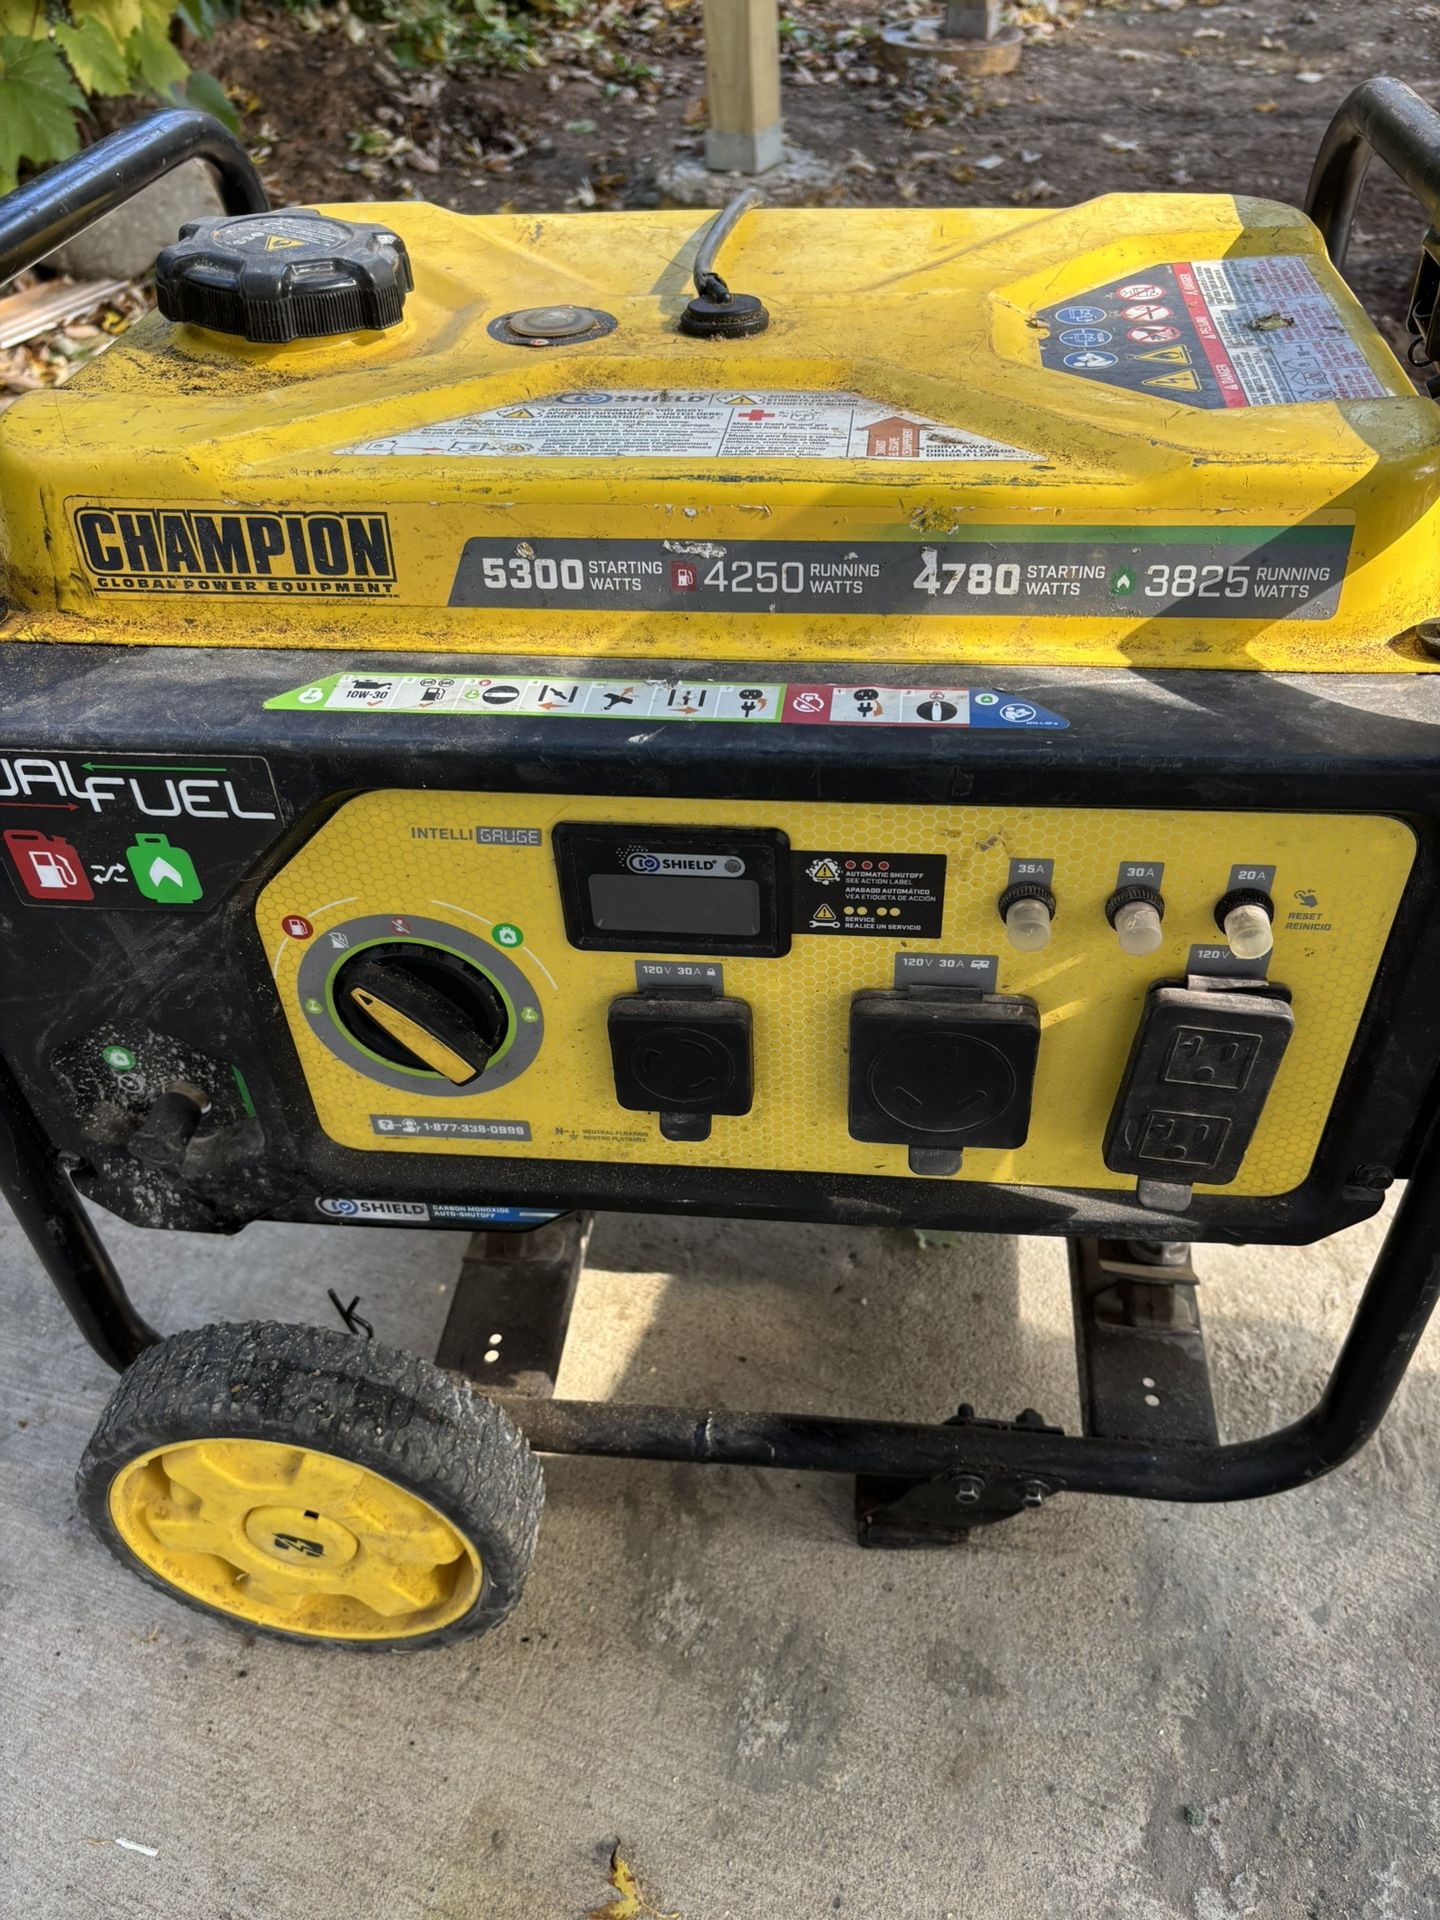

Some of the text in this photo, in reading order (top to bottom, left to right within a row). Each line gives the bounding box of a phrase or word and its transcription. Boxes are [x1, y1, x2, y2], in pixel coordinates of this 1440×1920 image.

[614, 395, 706, 403] SHIELD
[77, 512, 391, 578] CHAMPION
[482, 557, 663, 590] 5300 STARTING
[703, 560, 880, 593] 4250 RUNNING
[913, 561, 1106, 595] 4780 STARTING
[1144, 564, 1331, 598] 3825 RUNNING
[97, 577, 393, 594] GLOBAL POWER EQUIPMENT
[589, 576, 642, 591] WATTS
[810, 579, 863, 594] WATTS
[1025, 581, 1081, 596] WATTS
[1253, 583, 1310, 599] WATTS
[346, 690, 389, 700] 10W-30
[411, 827, 539, 844] INTELLI GAUGE
[662, 859, 714, 871] SHIELD
[1288, 912, 1323, 921] RESET
[1285, 922, 1332, 931] REINICIO
[360, 1201, 425, 1215] SHIELD
[432, 1204, 466, 1212] CARBON
